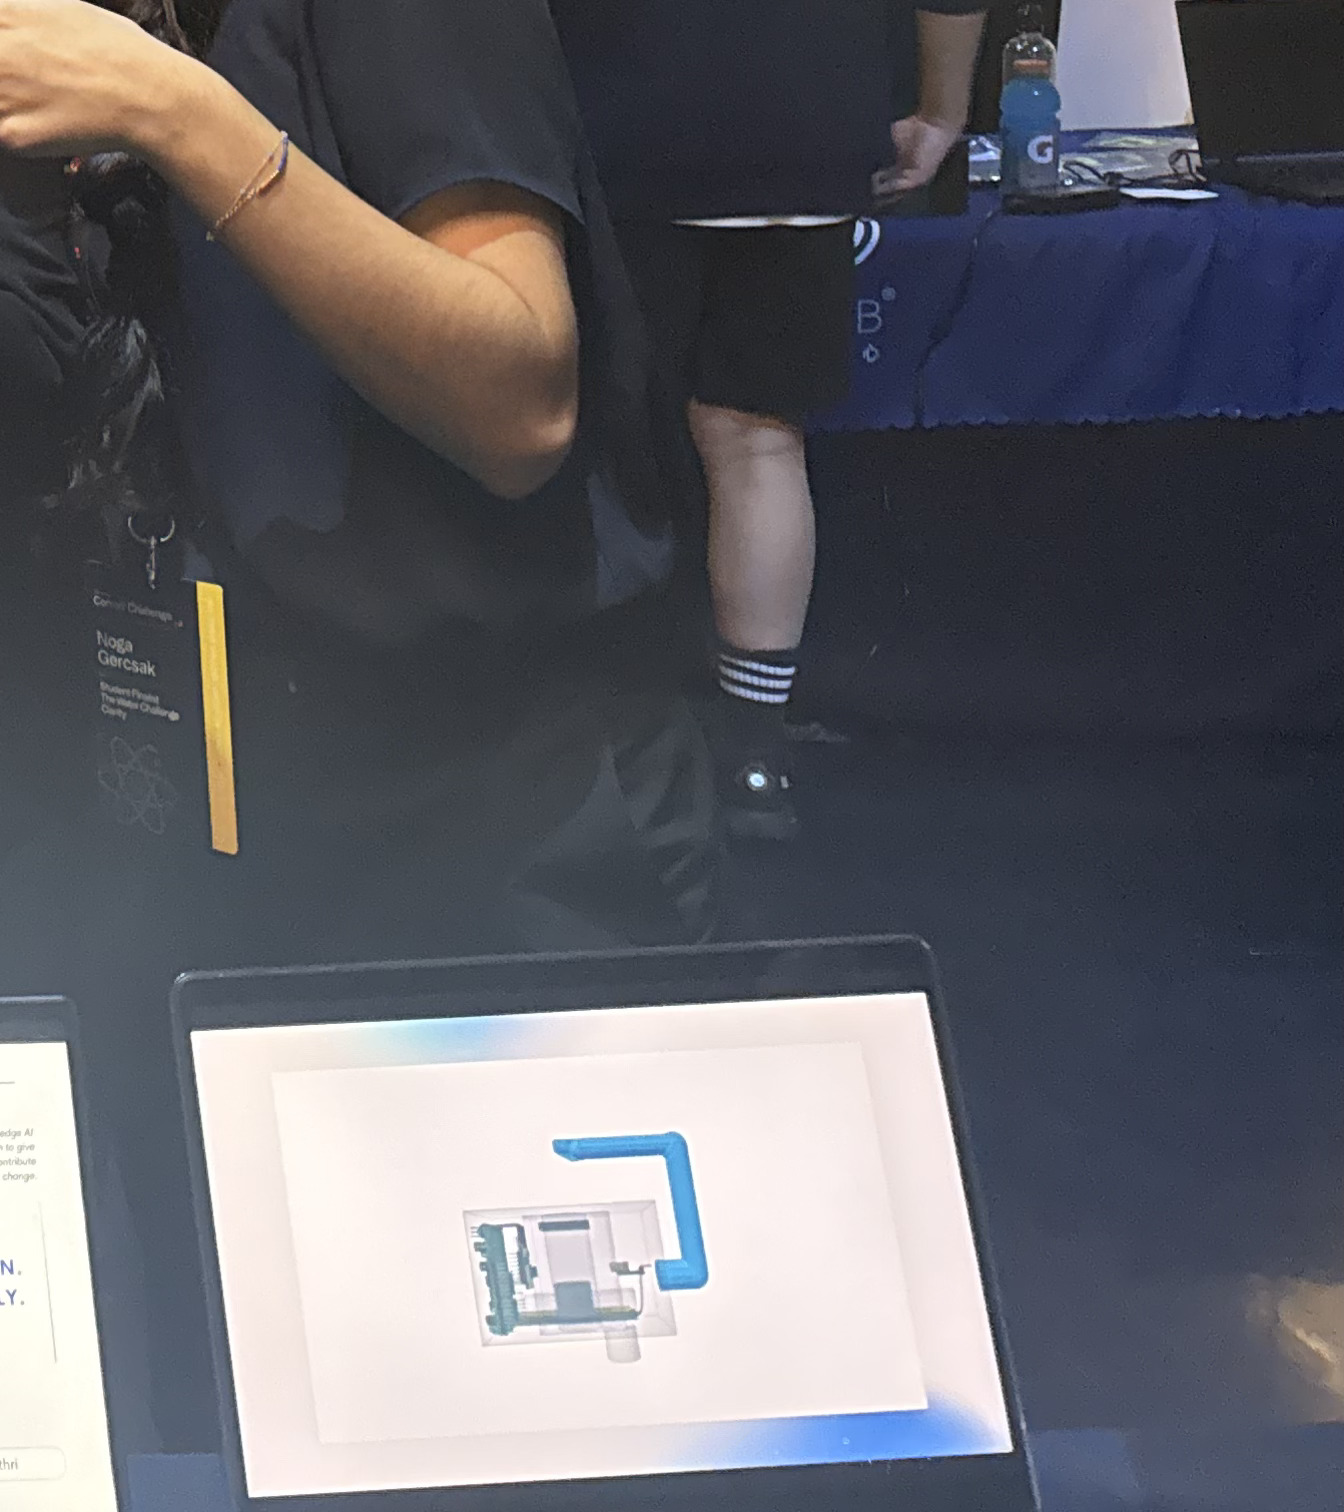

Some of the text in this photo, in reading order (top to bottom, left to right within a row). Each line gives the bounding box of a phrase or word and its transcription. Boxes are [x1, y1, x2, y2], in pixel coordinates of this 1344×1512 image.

[1027, 134, 1054, 164] G
[96, 629, 133, 654] Noga
[24, 1128, 34, 1137] AI
[6, 1143, 15, 1152] to
[17, 1143, 36, 1154] give
